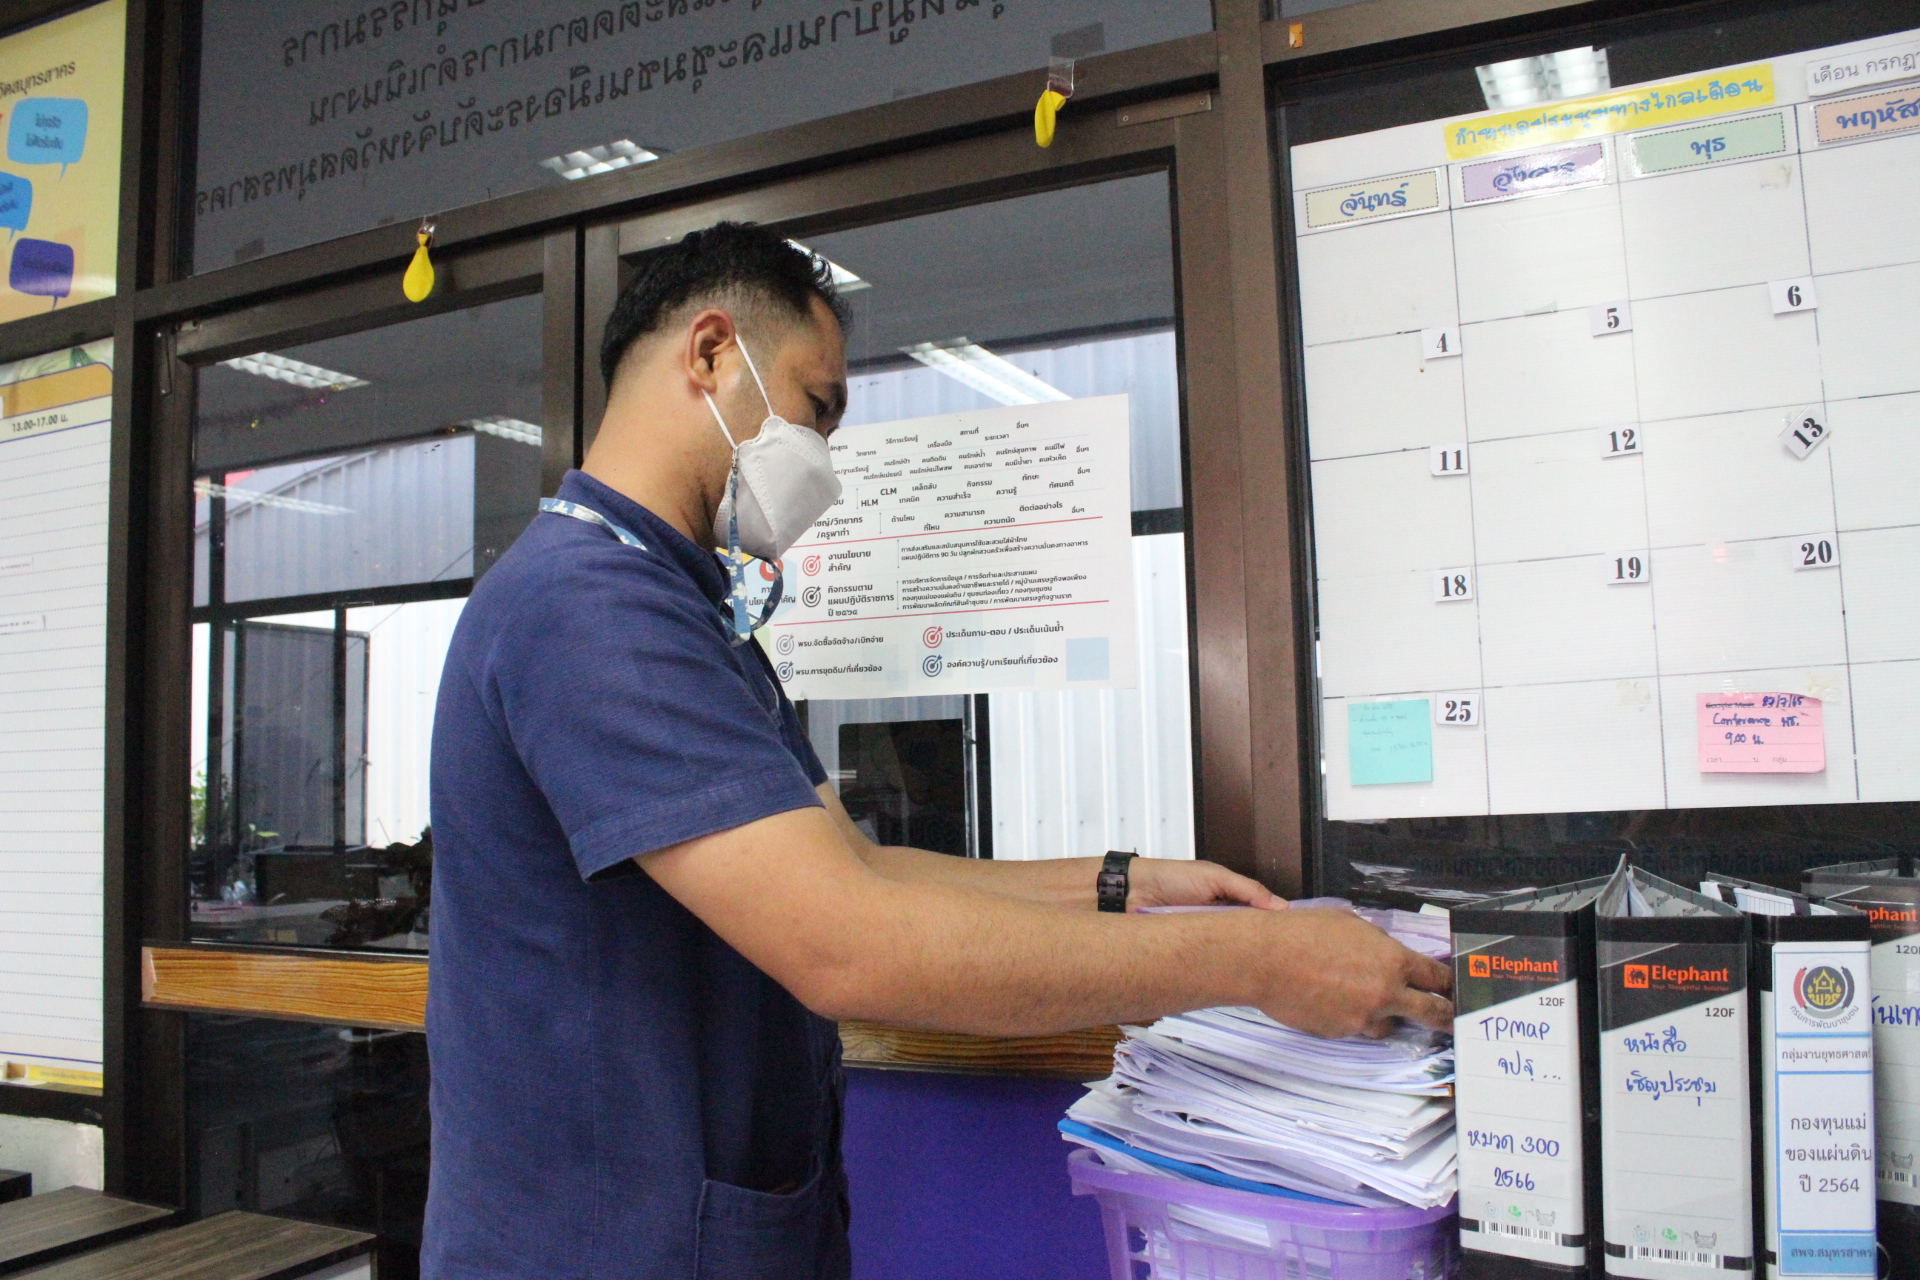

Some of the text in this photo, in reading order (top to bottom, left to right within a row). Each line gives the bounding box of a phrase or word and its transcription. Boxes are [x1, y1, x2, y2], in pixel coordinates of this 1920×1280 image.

[1812, 60, 1860, 85] เดือน
[1690, 135, 1726, 161] พุธ
[1836, 98, 1920, 131] พฤหัส
[1786, 286, 1802, 308] 6
[1606, 308, 1620, 329] 5
[1436, 334, 1448, 352] 4
[11, 414, 58, 432] 13.00-17.00
[960, 427, 979, 435] สถานที่
[1016, 421, 1029, 429] อื่นๆ
[1608, 429, 1636, 452] 12
[1791, 417, 1824, 449] 13
[927, 440, 952, 448] เครื่องมือ
[1438, 451, 1463, 472] 11
[880, 487, 897, 496] CLM
[912, 483, 937, 491] เคล็ดลับ
[1077, 466, 1090, 474] อื่นๆ
[861, 499, 878, 507] HLM
[937, 491, 971, 501] ความสำเร็จ
[996, 486, 1017, 495] ความรู้
[1049, 480, 1074, 488] ทัศนคติ
[944, 510, 985, 518] ความสามารถ
[1019, 501, 1063, 512] ติดต่ออย่างไร
[924, 523, 940, 531] ที่ไหน
[984, 516, 1016, 526] ความถนัด
[828, 550, 871, 560] งานนโยบาย
[1800, 540, 1833, 564] 20
[828, 563, 851, 571] สำคัญ
[1614, 556, 1642, 579] 19
[828, 584, 873, 593] กิจกรรมตาม
[1440, 575, 1468, 598] 18
[828, 594, 894, 605] แผนปฏิบัติราชการ
[828, 608, 833, 616] ปี
[798, 636, 883, 647] พรบ.จัดซื้อจัดจ้าง/เบิกจ่าย
[946, 628, 1006, 638] ประเด็นถาม-ตอบ
[1014, 621, 1064, 634] ประเด็นเน้นย้ำ
[947, 655, 1058, 668] องค์ความรู้/บทเรียนที่เกี่ยวข้อง
[1445, 701, 1472, 722] 25
[1713, 713, 1772, 726] Conference
[1857, 906, 1917, 922] phant
[1896, 944, 1920, 955] 120
[1492, 956, 1558, 974] Elephant
[1652, 965, 1729, 984] Elephant
[1539, 997, 1565, 1006] 120F
[1705, 1007, 1735, 1017] 120F
[1790, 1005, 1859, 1029] กรมการพัฒนาชุมชน
[1626, 1070, 1716, 1106] เชิญประชุม
[1791, 1113, 1866, 1135] กองทุนแม่
[1468, 1130, 1559, 1156] หมวด 300
[1785, 1143, 1872, 1161] ของแผ่นดิน
[1494, 1167, 1534, 1190] 2566
[1800, 1174, 1860, 1192] ปี 2564
[1791, 1247, 1873, 1261] สพจ.สมุทรสาคร
